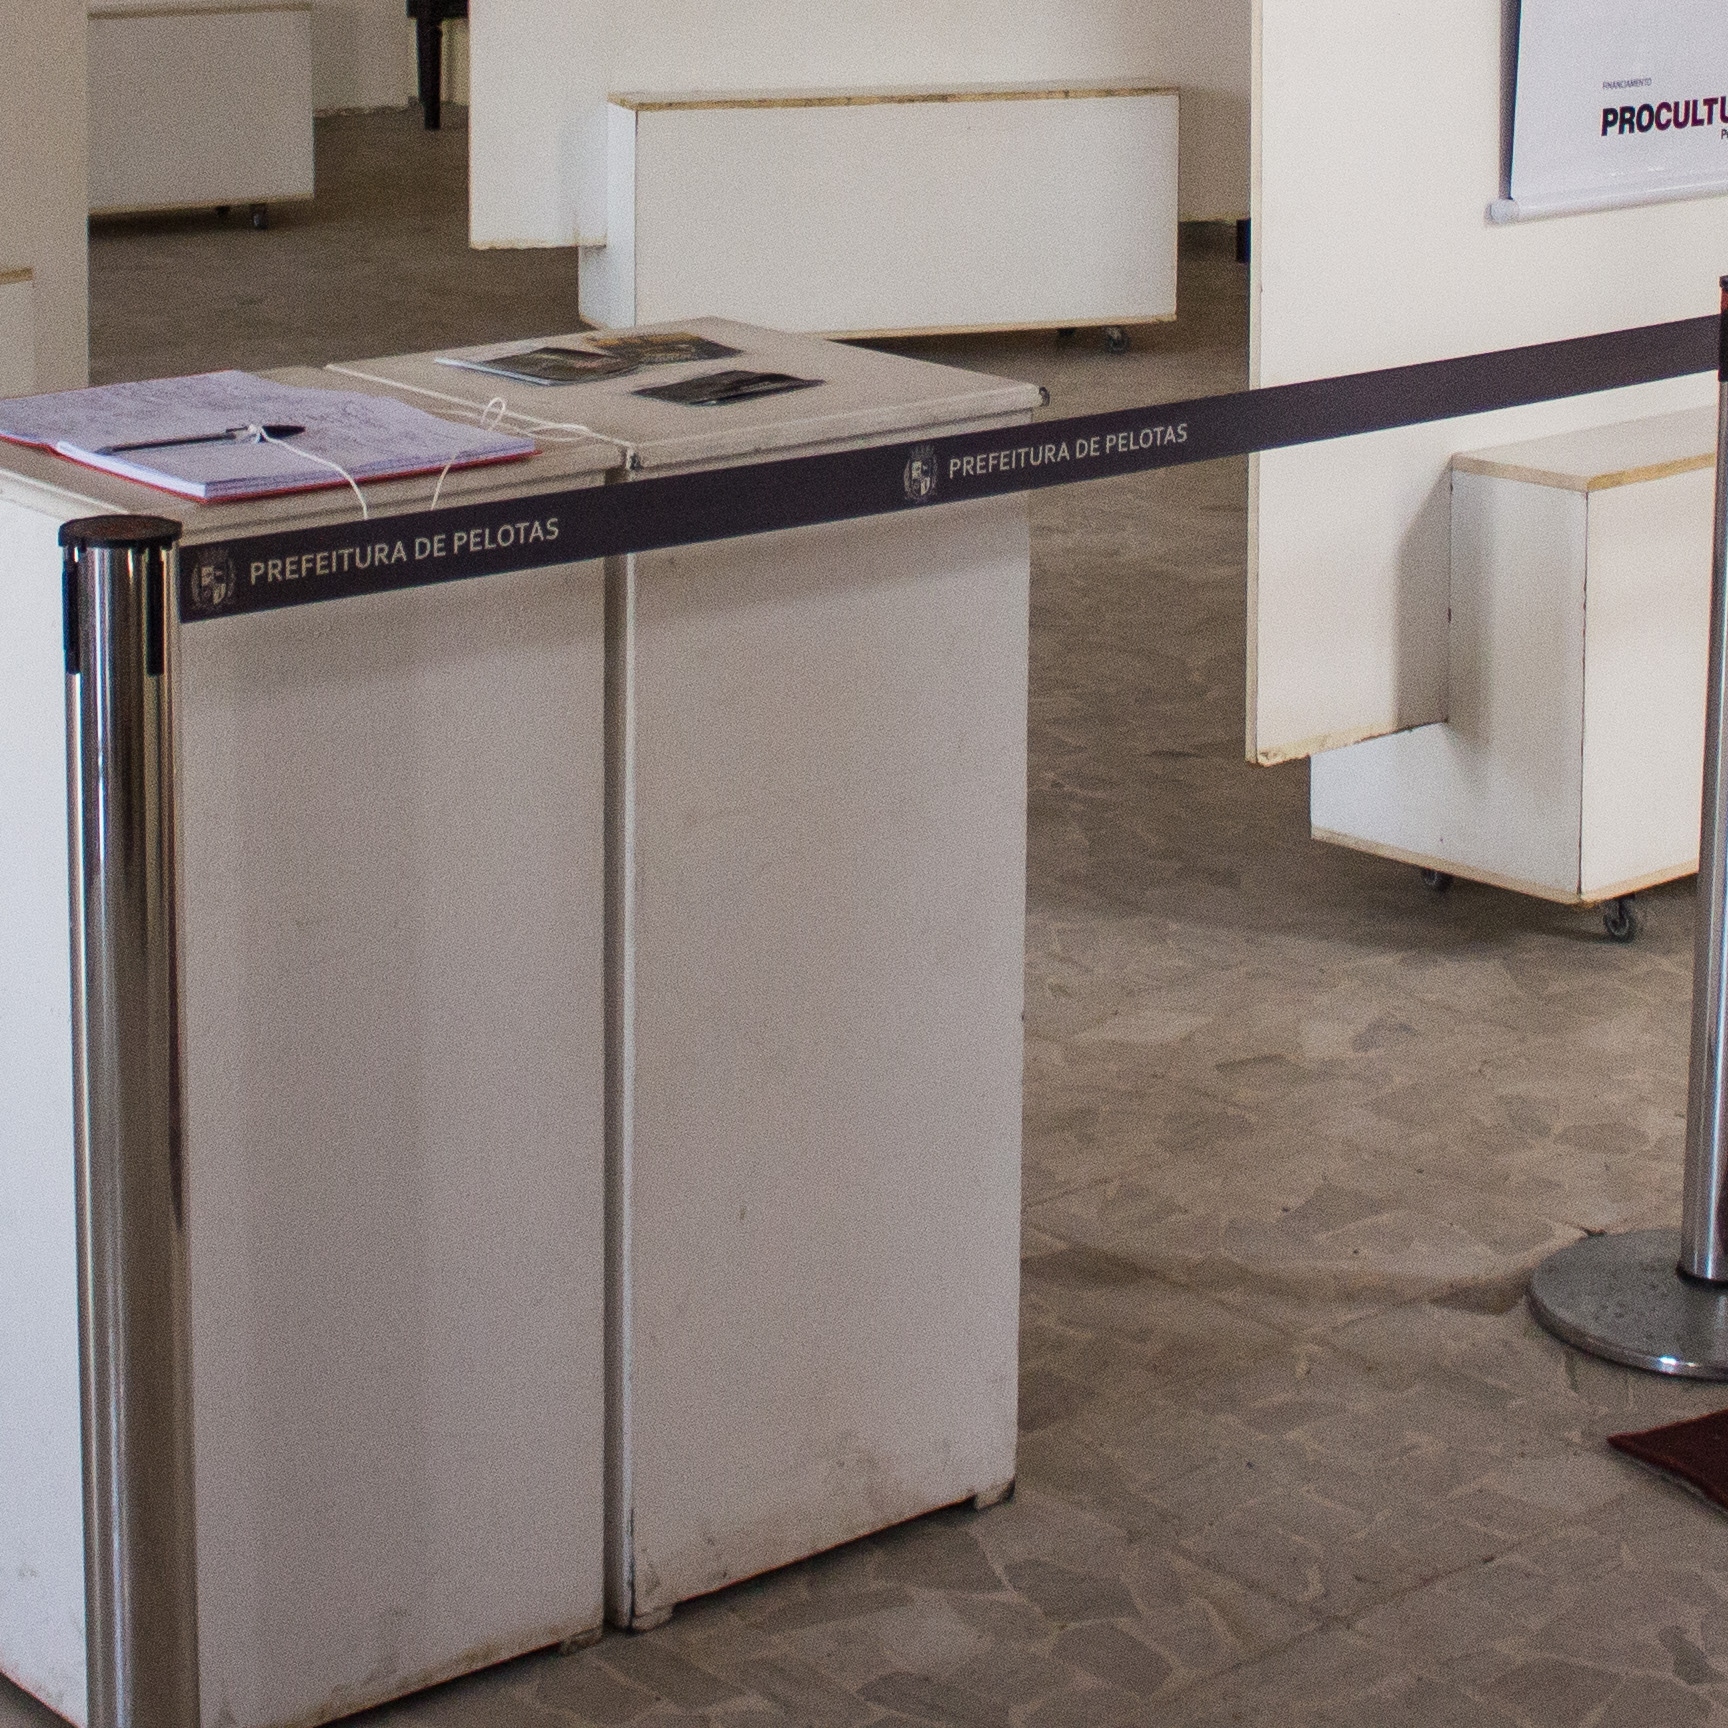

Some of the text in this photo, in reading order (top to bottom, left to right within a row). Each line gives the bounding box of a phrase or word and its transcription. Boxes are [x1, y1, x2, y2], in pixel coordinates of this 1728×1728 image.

[949, 422, 1189, 480] PREFEITURA DE PELOTAS
[250, 517, 560, 586] PREFEITURA DE PELOTAS
